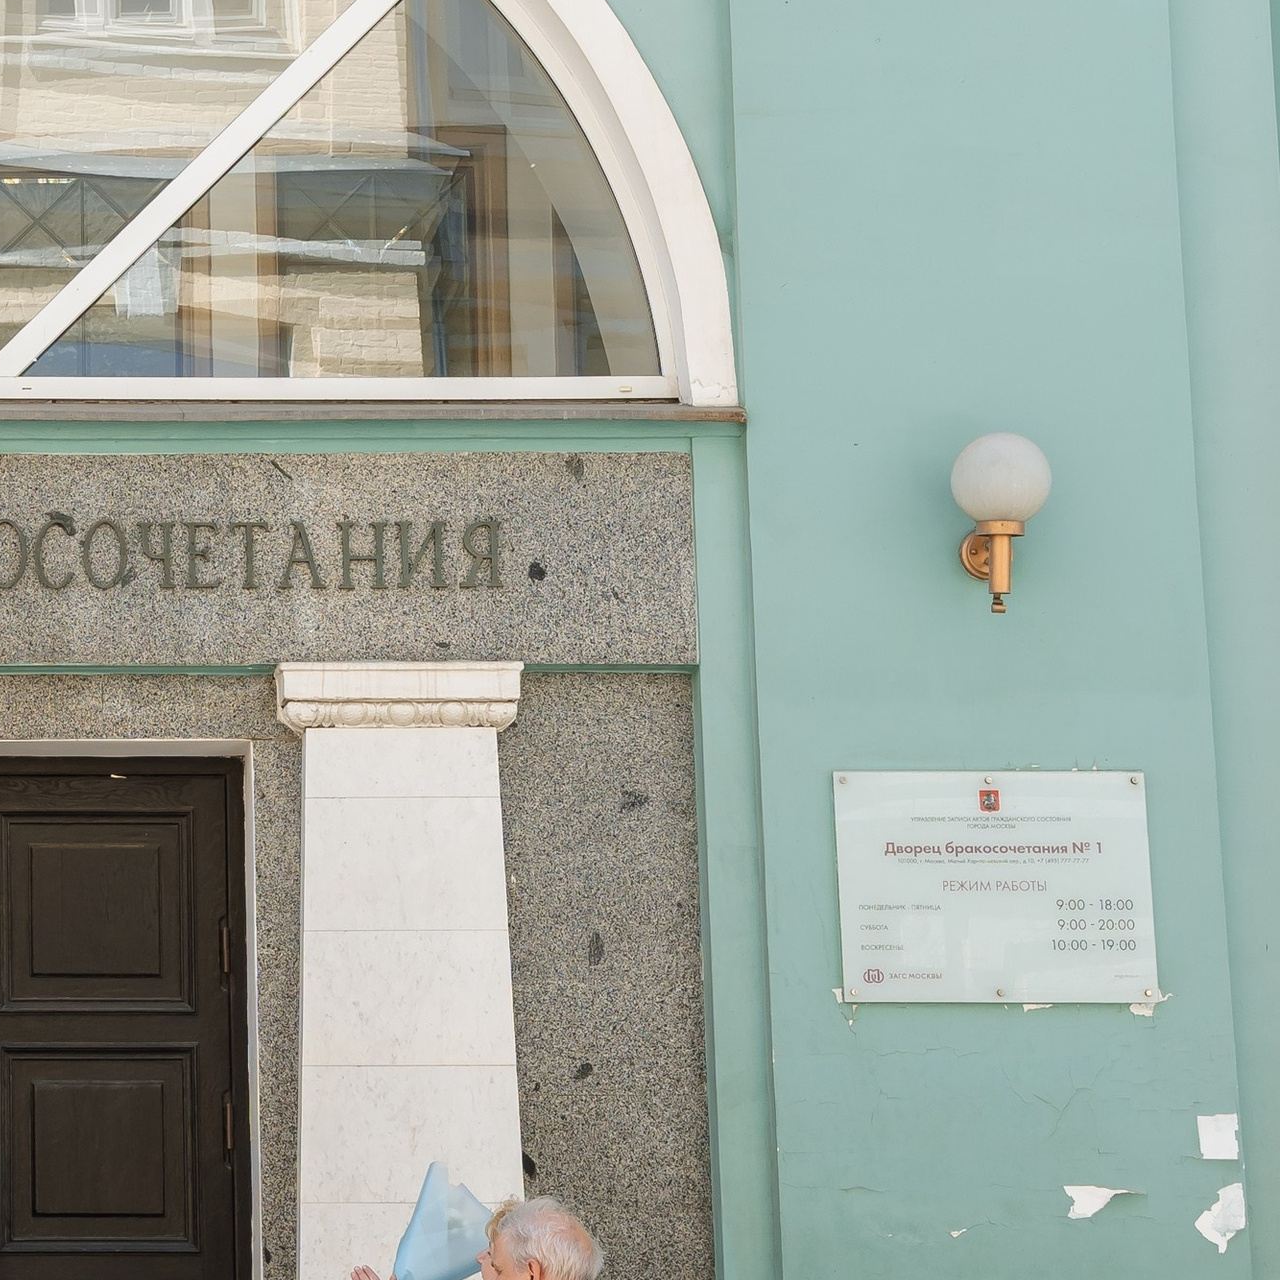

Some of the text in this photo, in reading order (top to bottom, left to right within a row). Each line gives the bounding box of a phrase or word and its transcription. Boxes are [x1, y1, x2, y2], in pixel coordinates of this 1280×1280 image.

[885, 841, 1102, 857] Дворец бракосочетания № 1
[942, 880, 1047, 891] РЕЖИМ РАБОТЫ
[1056, 899, 1085, 910] 9:00
[1099, 899, 1134, 910] 18:00
[1057, 919, 1086, 930] 9:00
[1098, 919, 1135, 930] 20:00
[1052, 939, 1088, 951] 10:00
[1101, 939, 1136, 951] 19:00
